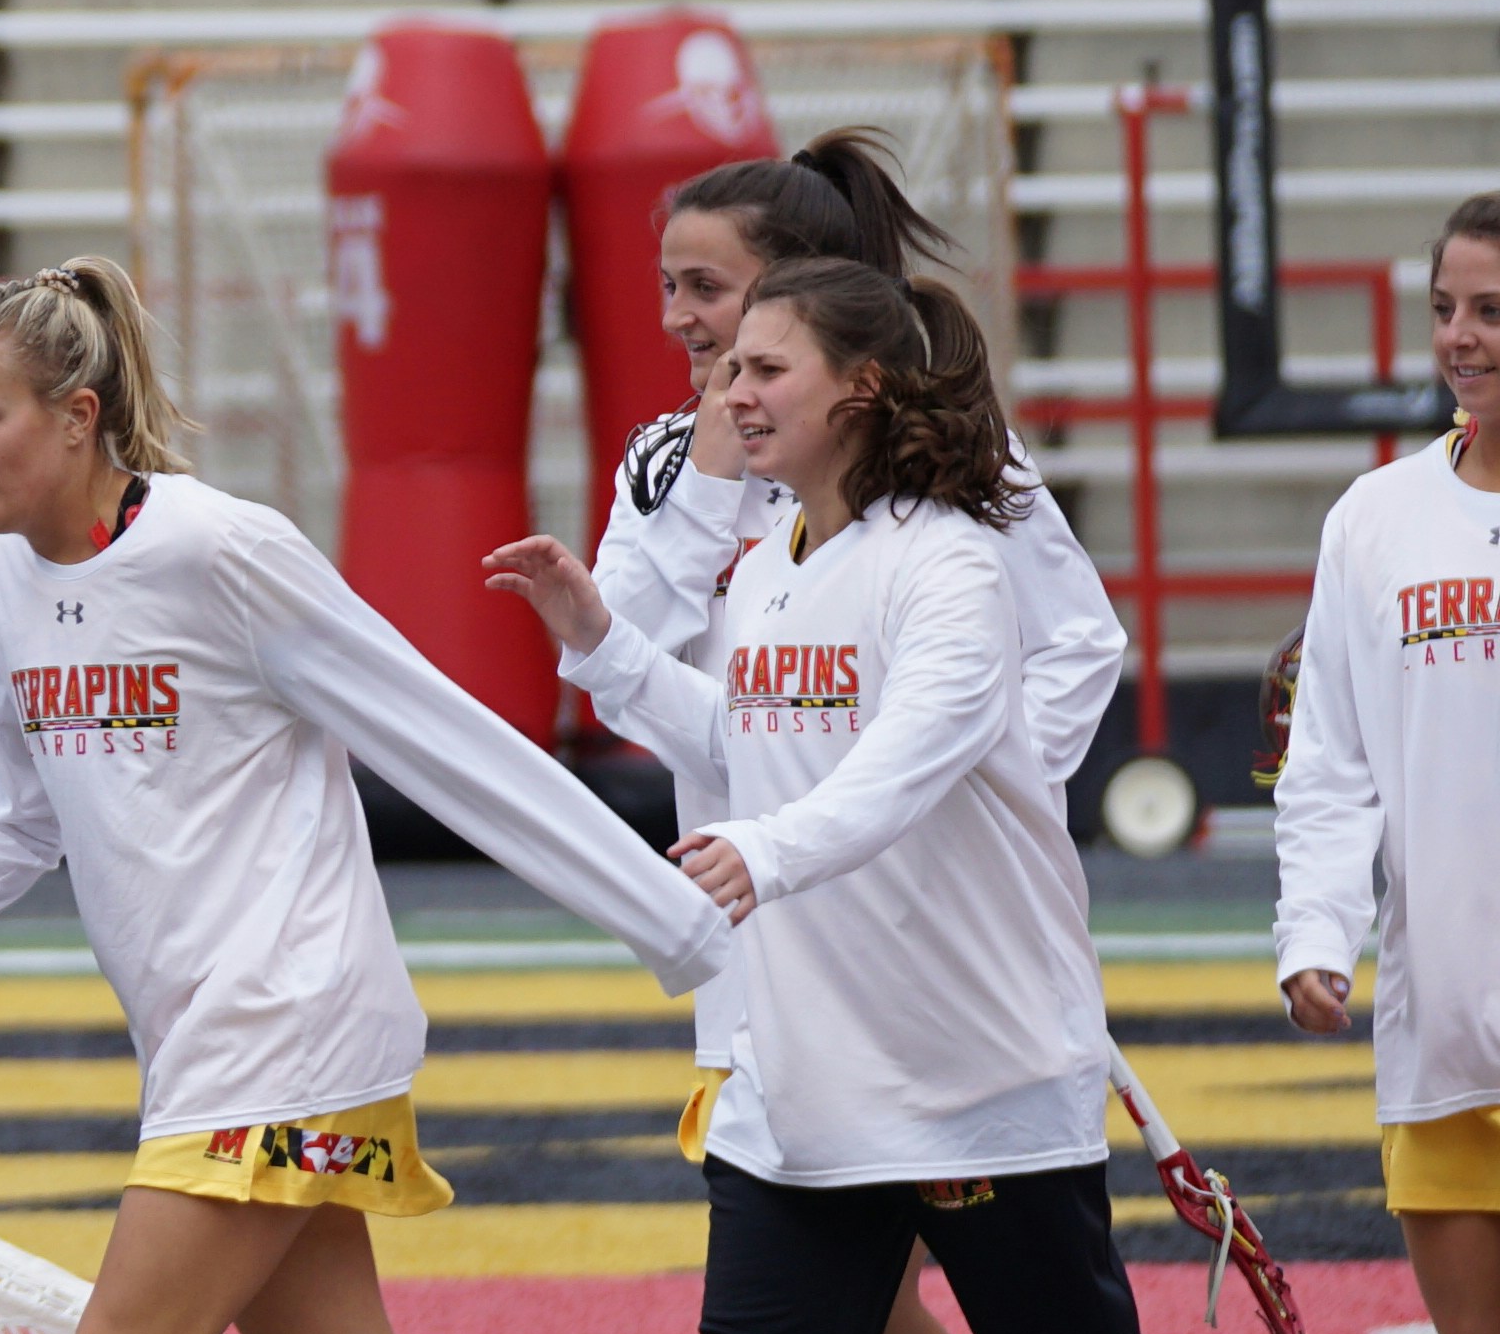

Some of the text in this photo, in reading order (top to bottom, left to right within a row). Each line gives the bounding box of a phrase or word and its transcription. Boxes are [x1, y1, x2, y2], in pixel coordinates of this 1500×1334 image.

[1397, 577, 1500, 634] TERR
[728, 644, 860, 698] RAPINS
[1403, 638, 1496, 670] ACR
[728, 710, 860, 737] ROSSE
[205, 1126, 250, 1160] M
